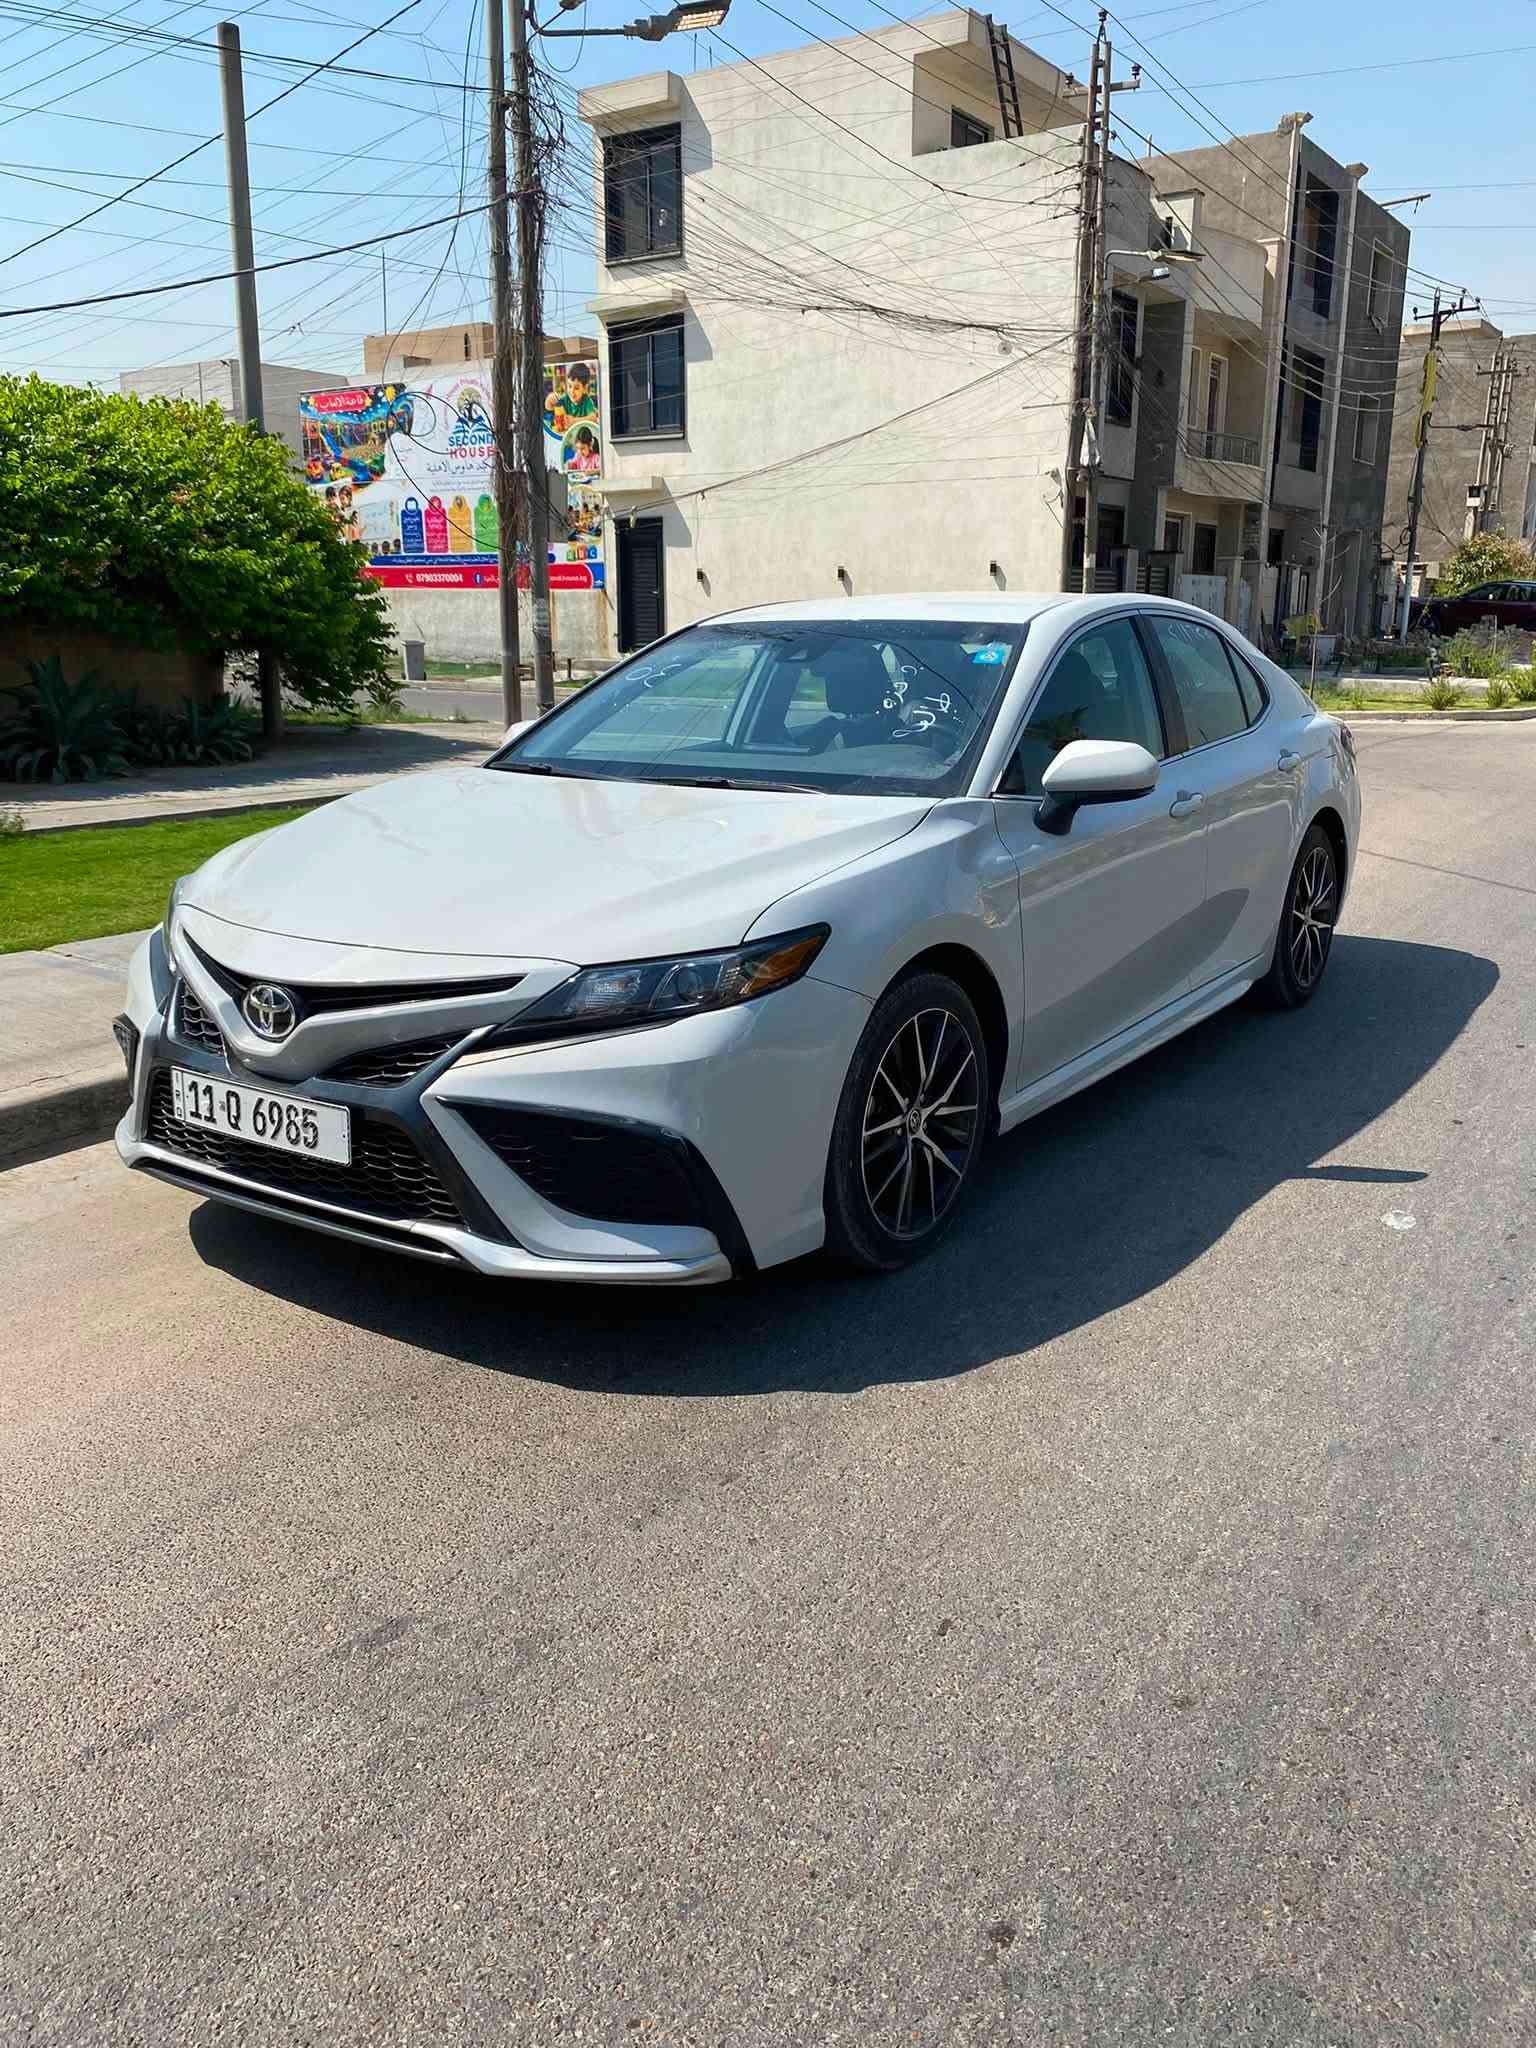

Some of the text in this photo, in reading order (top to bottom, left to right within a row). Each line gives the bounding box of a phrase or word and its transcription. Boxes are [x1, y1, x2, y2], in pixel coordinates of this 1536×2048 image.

[449, 446, 497, 459] HOUSE
[188, 1080, 217, 1125] 11
[225, 1090, 242, 1131] Q
[253, 1097, 319, 1149] 6985
